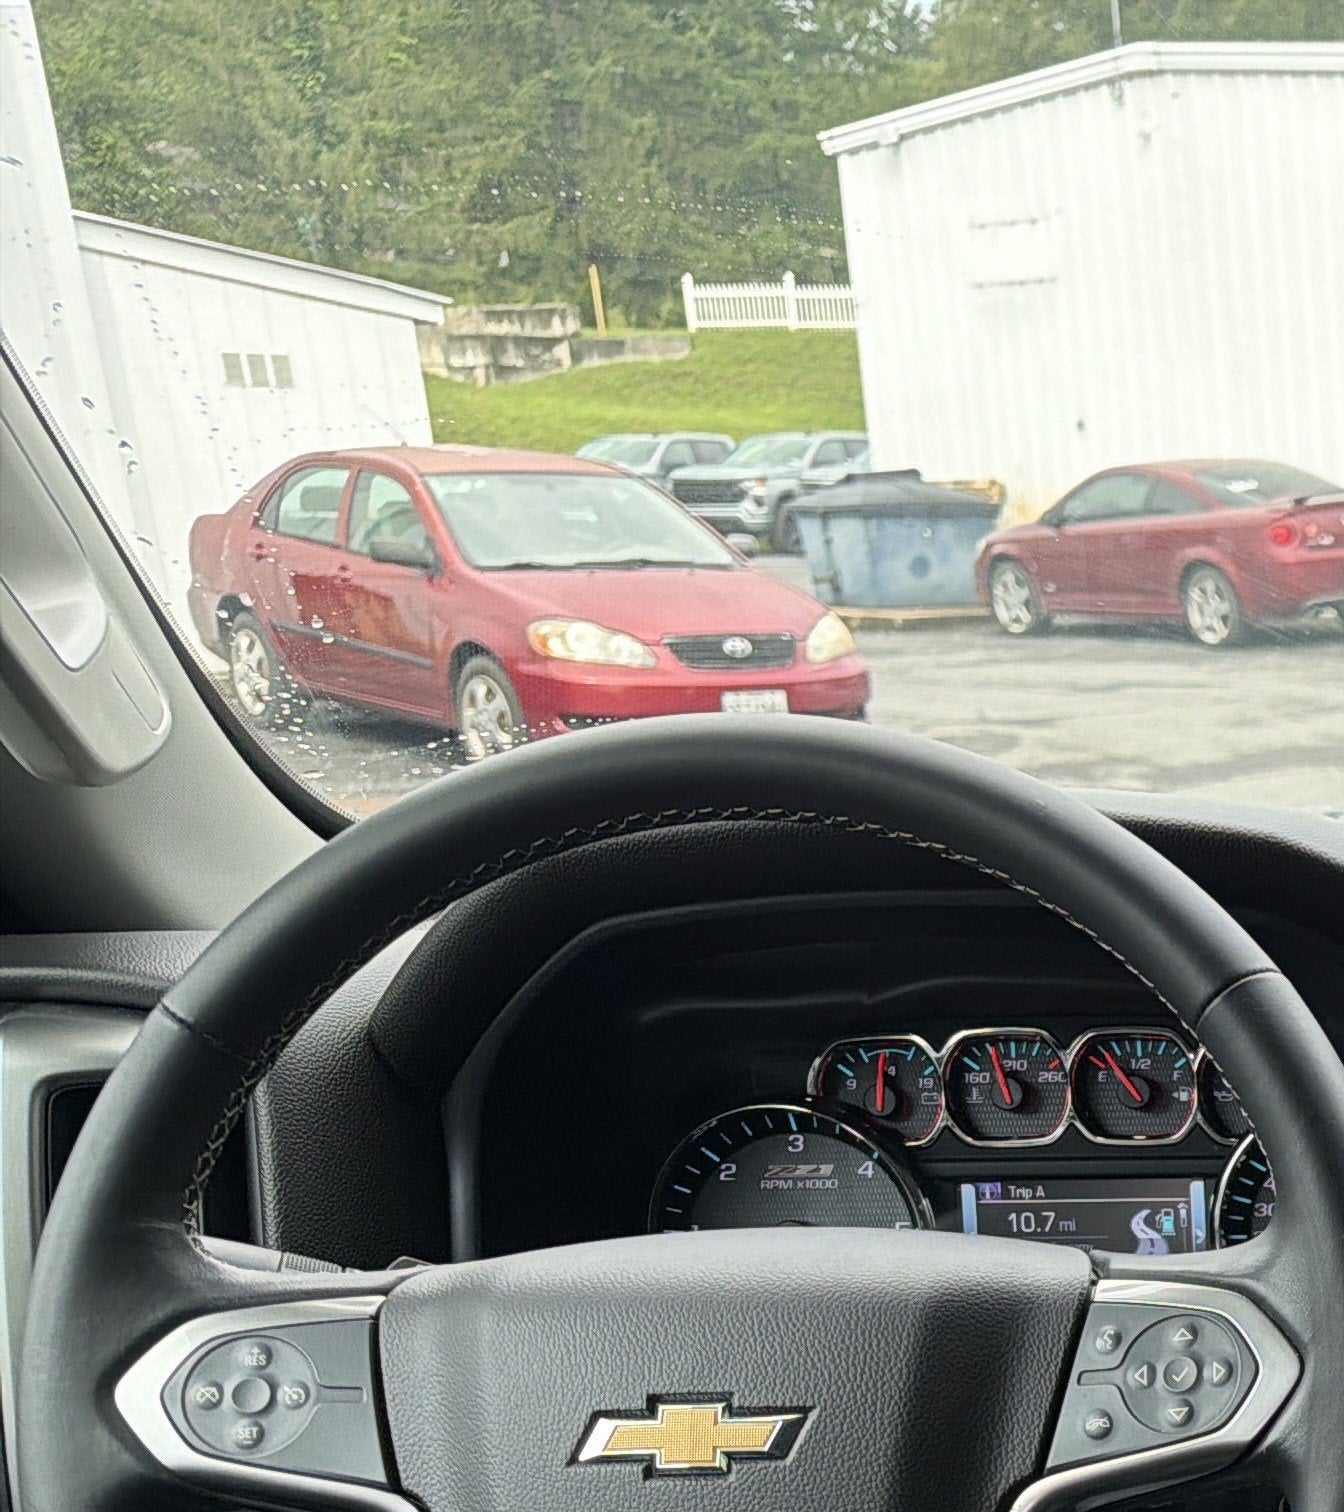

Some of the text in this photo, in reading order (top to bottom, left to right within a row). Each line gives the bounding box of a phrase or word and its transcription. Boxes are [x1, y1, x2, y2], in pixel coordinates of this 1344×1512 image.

[1130, 1058, 1151, 1070] 1/2
[917, 1077, 934, 1089] 19
[964, 1071, 991, 1084] 160
[1098, 1071, 1107, 1082] E
[846, 1078, 858, 1091] 9
[787, 1134, 804, 1153] 3
[719, 1163, 737, 1181] 2
[857, 1160, 874, 1179] 4
[760, 1179, 793, 1190] RPM
[1008, 1185, 1046, 1199] Trip A
[1007, 1211, 1076, 1233] 10.7 mi
